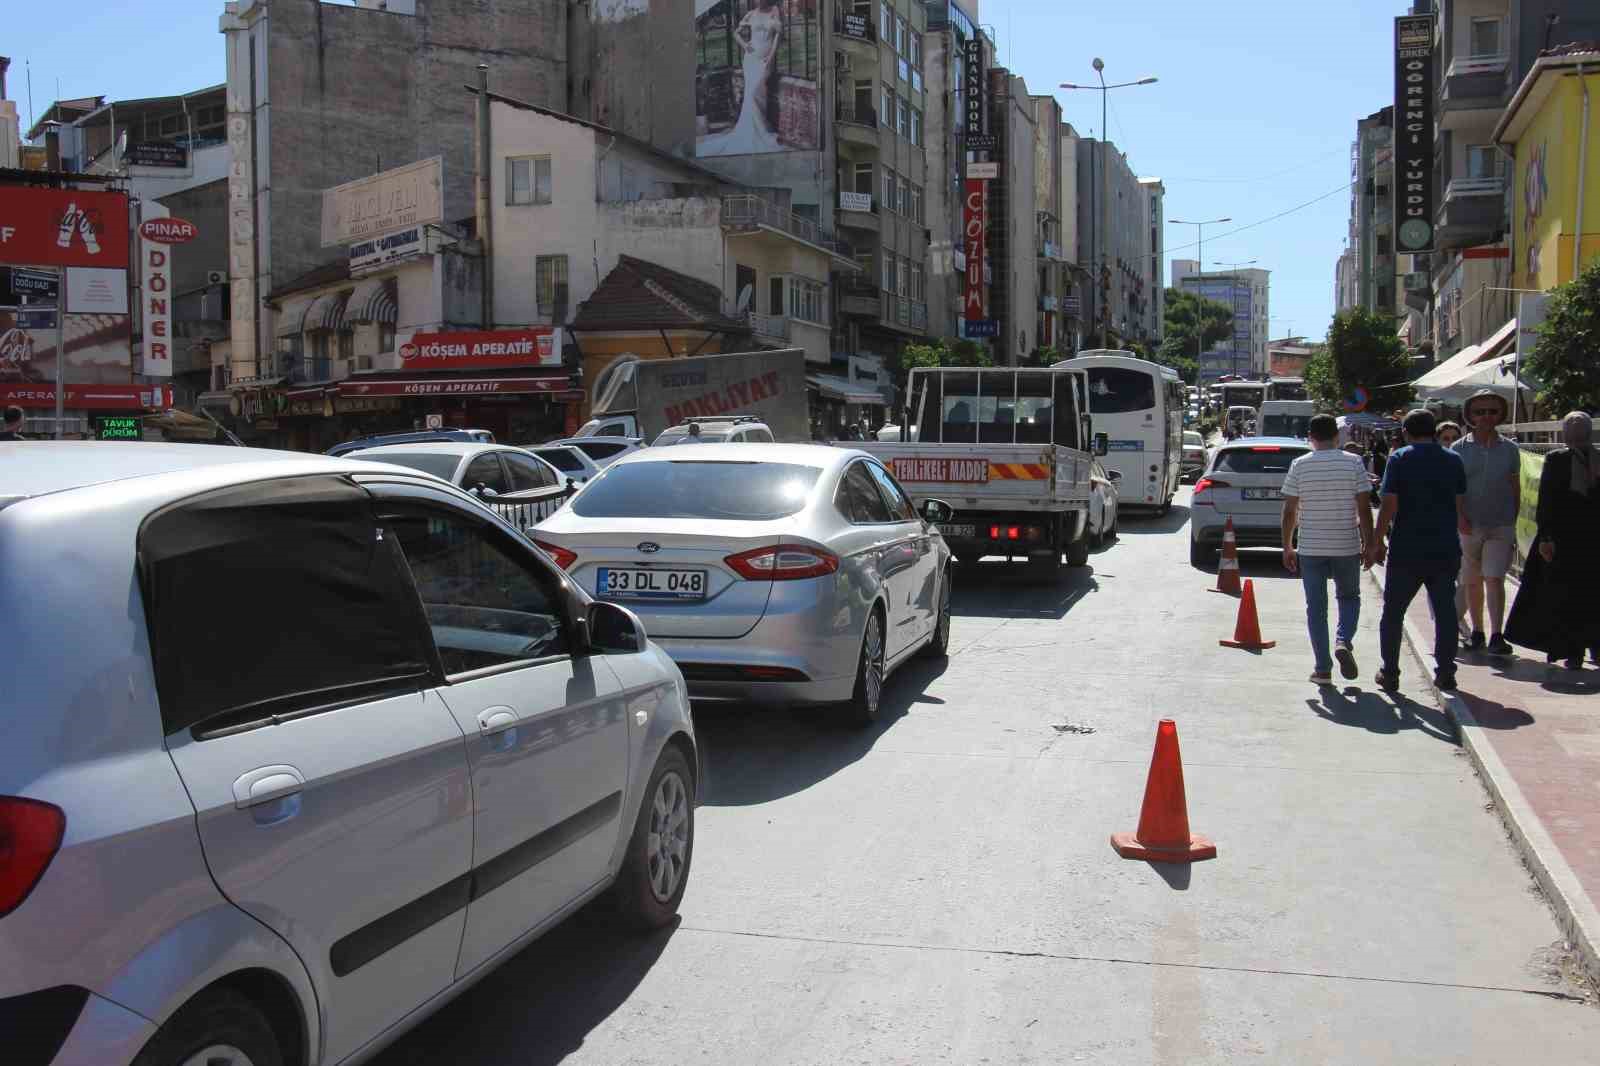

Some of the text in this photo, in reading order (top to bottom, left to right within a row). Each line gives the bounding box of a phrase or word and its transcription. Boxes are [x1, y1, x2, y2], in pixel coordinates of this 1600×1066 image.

[1407, 158, 1423, 216] YURDU
[145, 223, 192, 236] PINAR
[149, 250, 167, 360] DÖNER
[472, 337, 533, 356] APERATİF
[950, 459, 987, 481] MADDE
[608, 572, 701, 591] 33 DL 048
